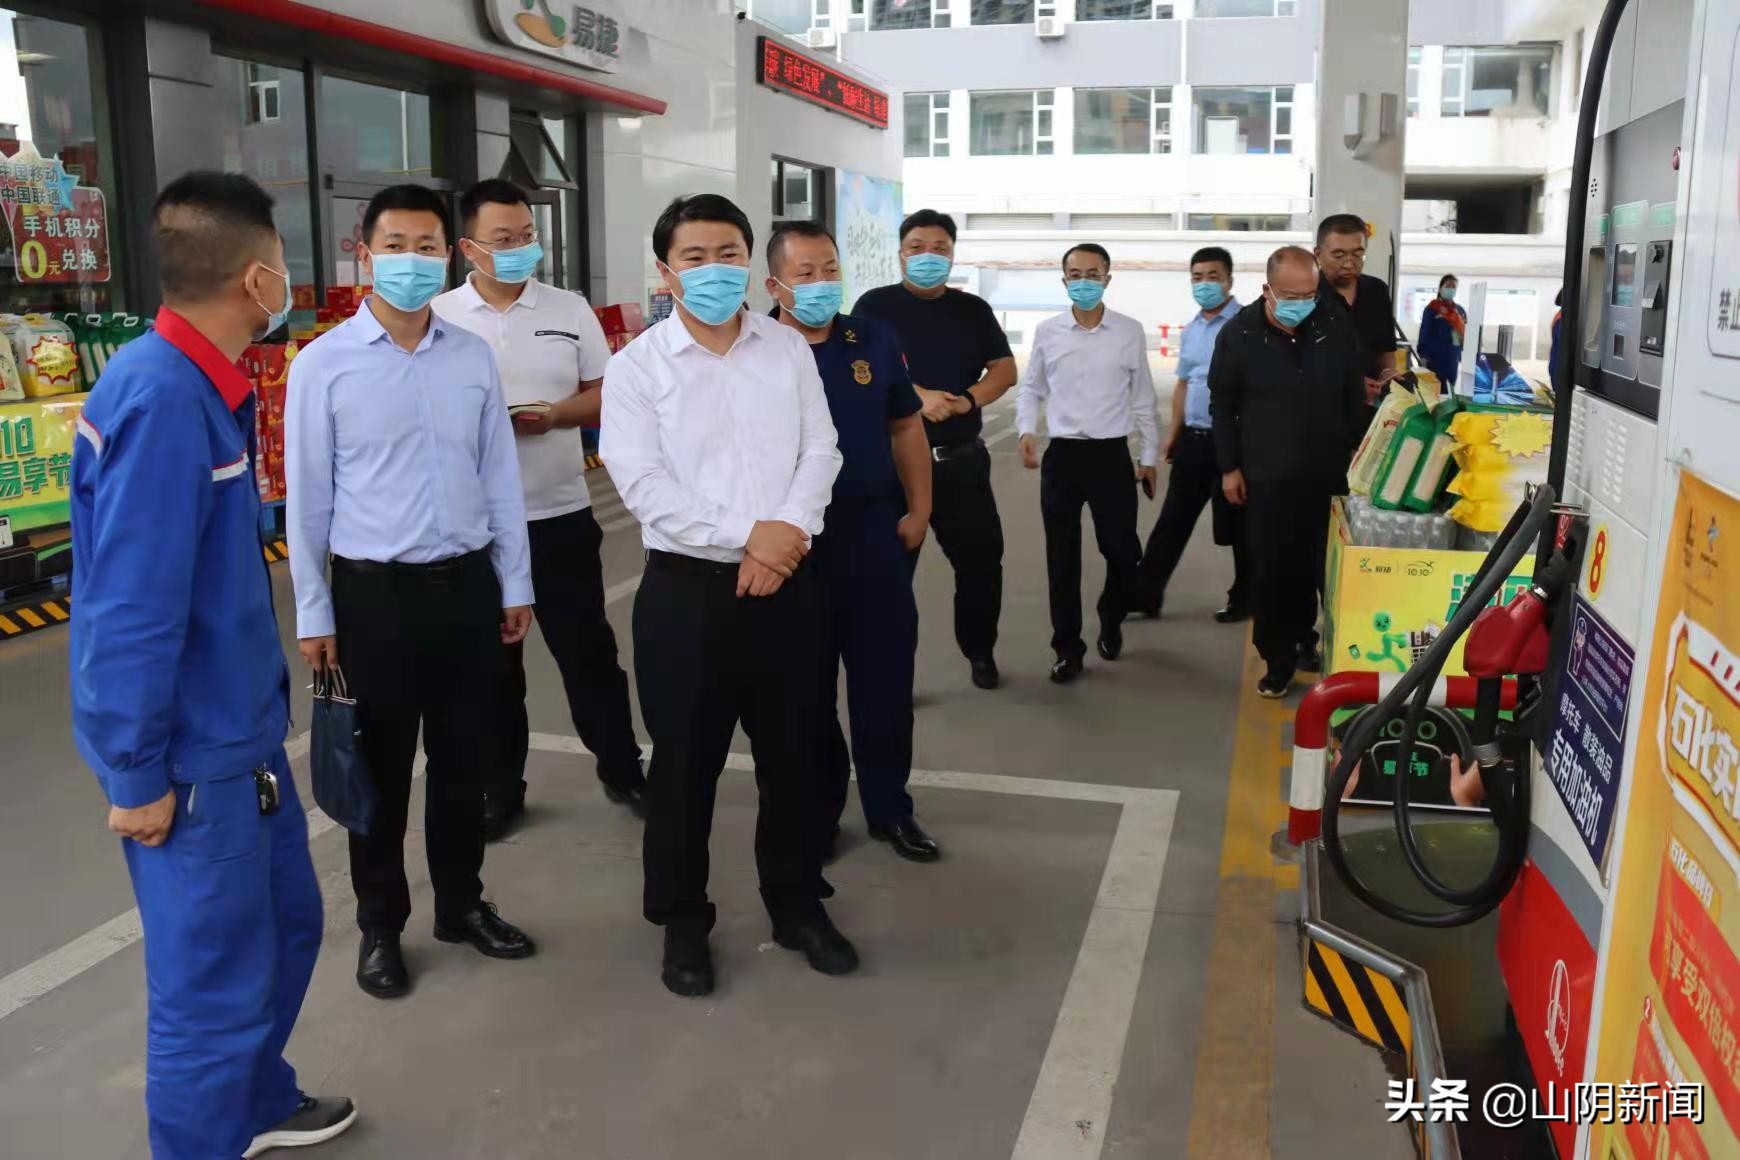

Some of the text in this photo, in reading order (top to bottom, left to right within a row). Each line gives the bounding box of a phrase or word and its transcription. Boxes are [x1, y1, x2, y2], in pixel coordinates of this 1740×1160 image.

[573, 5, 619, 58] 易捷
[2, 187, 61, 206] 中国联通
[24, 216, 100, 238] 手机积分
[1590, 530, 1606, 593] 8
[1550, 728, 1603, 846] 专用加油机
